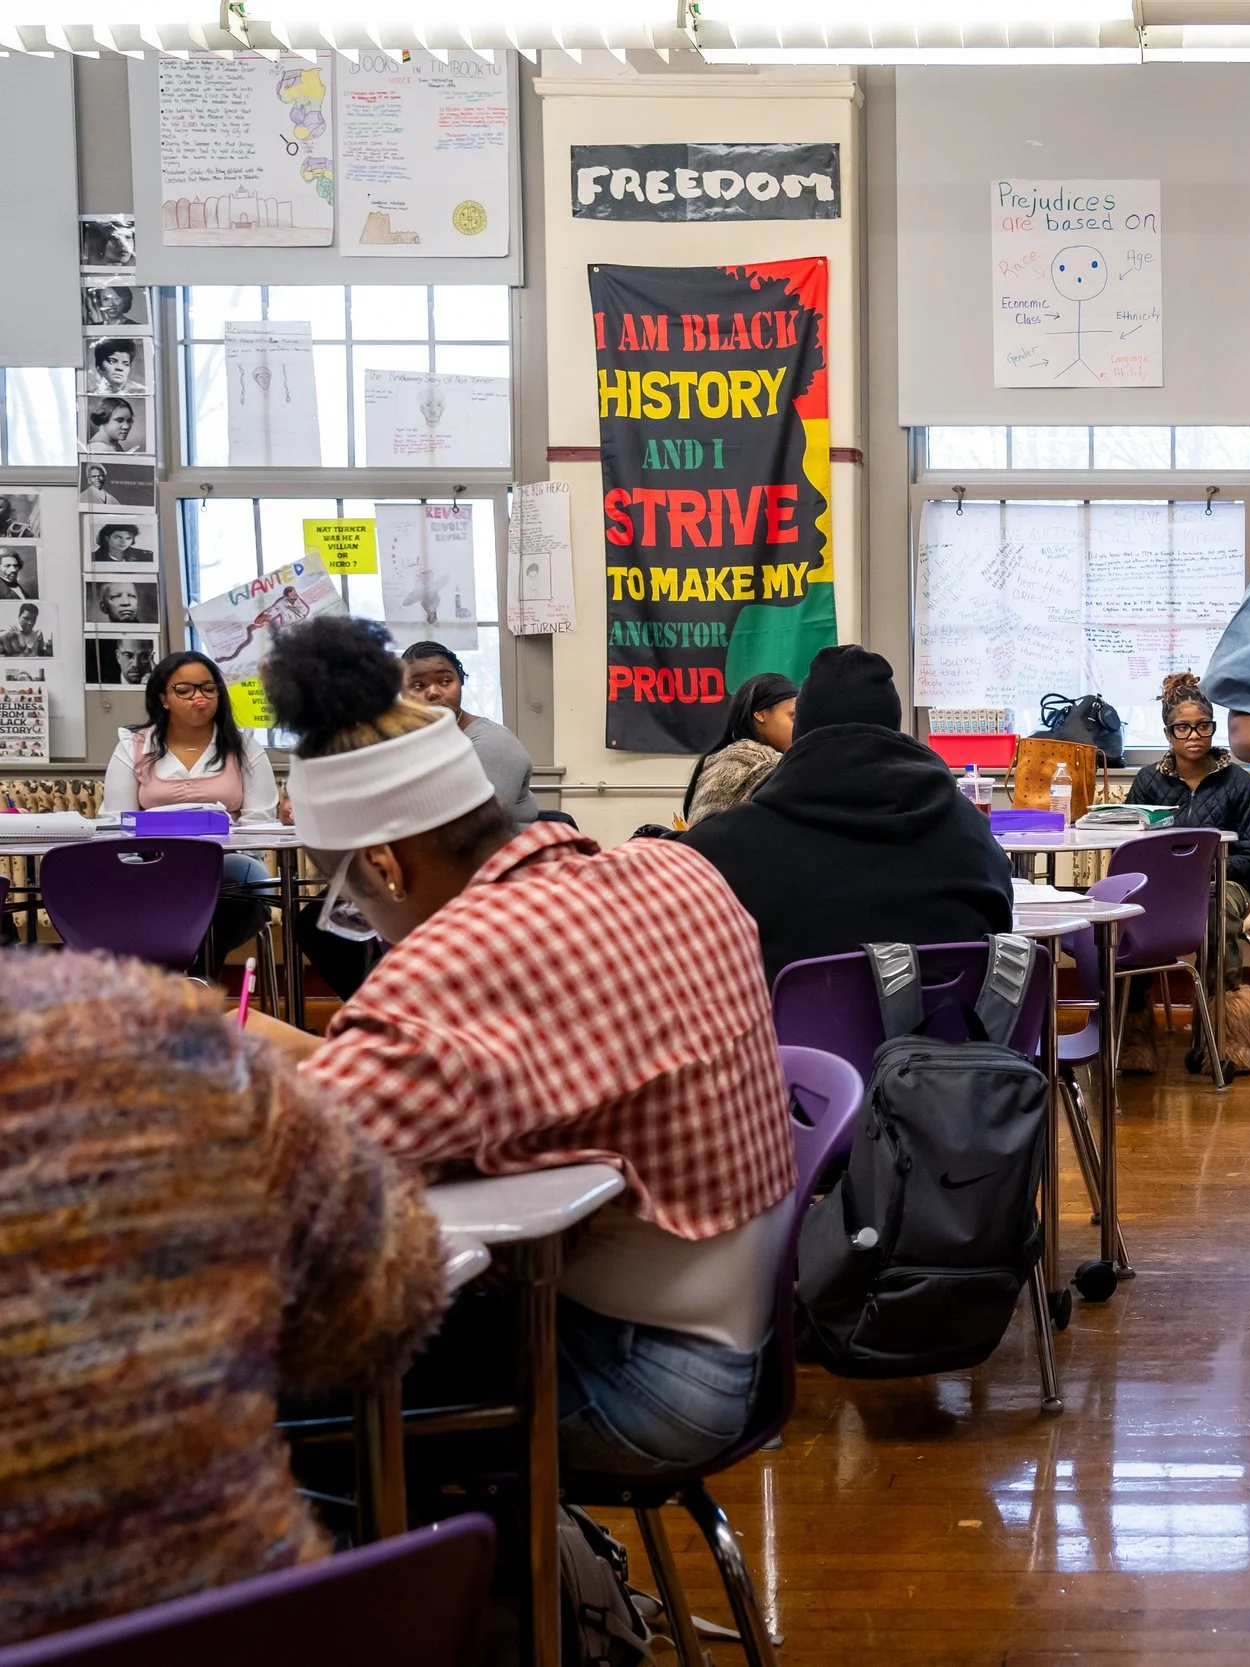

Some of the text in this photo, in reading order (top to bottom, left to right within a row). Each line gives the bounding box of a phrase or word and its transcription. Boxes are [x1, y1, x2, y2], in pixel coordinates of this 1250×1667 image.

[349, 56, 400, 74] BOOKS
[412, 66, 422, 74] IN
[577, 166, 835, 206] FREEDOM
[999, 181, 1116, 218] Prejudices
[1002, 213, 1157, 234] are based on
[998, 250, 1041, 279] Race
[1126, 248, 1156, 271] Age
[1001, 296, 1050, 310] Economic
[1116, 307, 1161, 323] Ethnicity
[593, 310, 800, 352] I AM BLACK
[1015, 312, 1042, 326] Class
[1007, 345, 1039, 368] Gender
[597, 366, 788, 420] HISTORY
[642, 438, 725, 470] AND I
[546, 482, 570, 494] HERO
[604, 484, 799, 549] STRIVE
[327, 543, 359, 551] VILLIAN
[336, 552, 349, 560] OR
[229, 563, 305, 606] WANTED
[607, 560, 810, 602] TO MAKE MY
[531, 621, 574, 634] TURNER
[608, 620, 730, 648] ANCESTOR
[607, 664, 726, 704] PROUD
